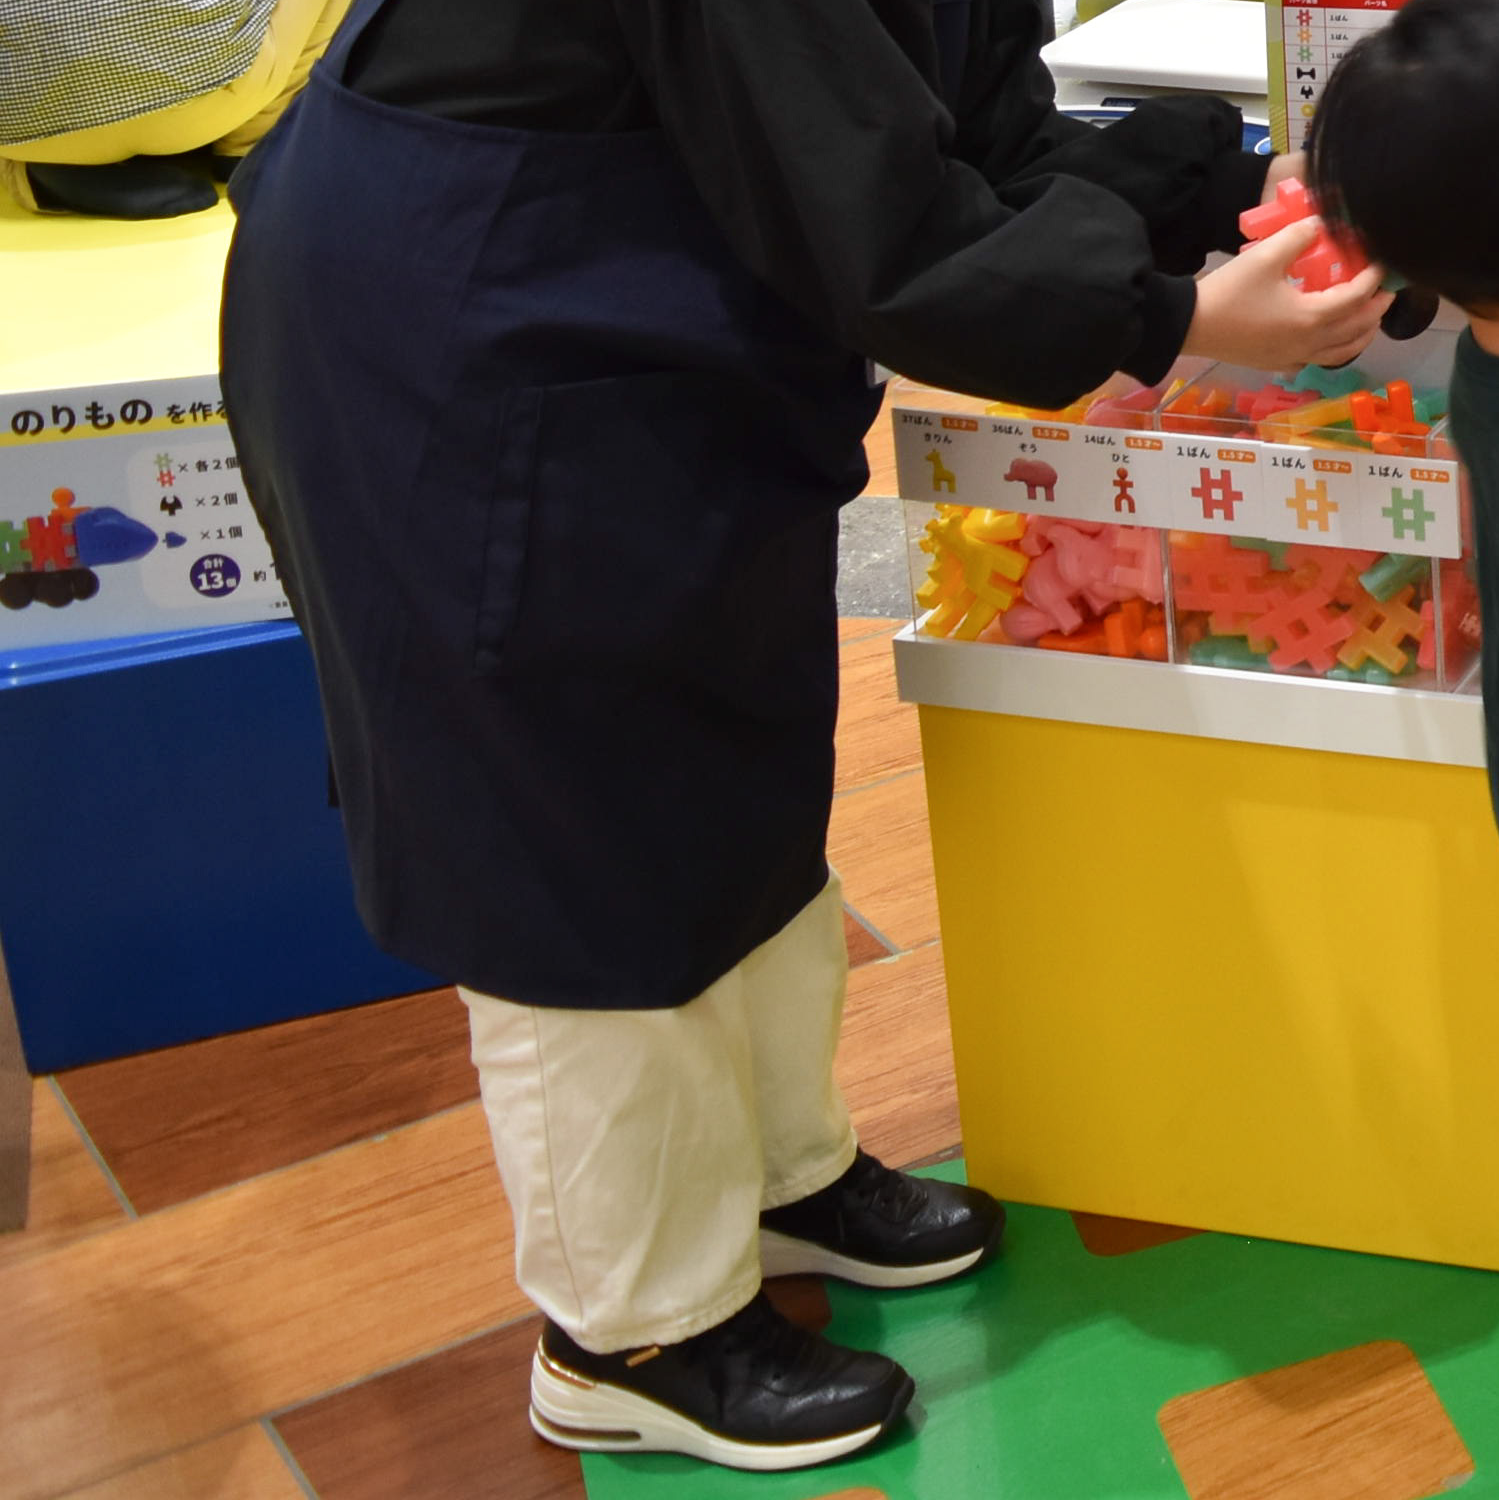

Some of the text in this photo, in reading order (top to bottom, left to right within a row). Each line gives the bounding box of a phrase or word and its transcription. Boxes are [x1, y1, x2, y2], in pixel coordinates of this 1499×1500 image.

[1112, 453, 1129, 463] ひと
[1177, 446, 1210, 459] 1ばん
[1272, 456, 1305, 469] 1ばん
[1368, 465, 1403, 479] 1ばん
